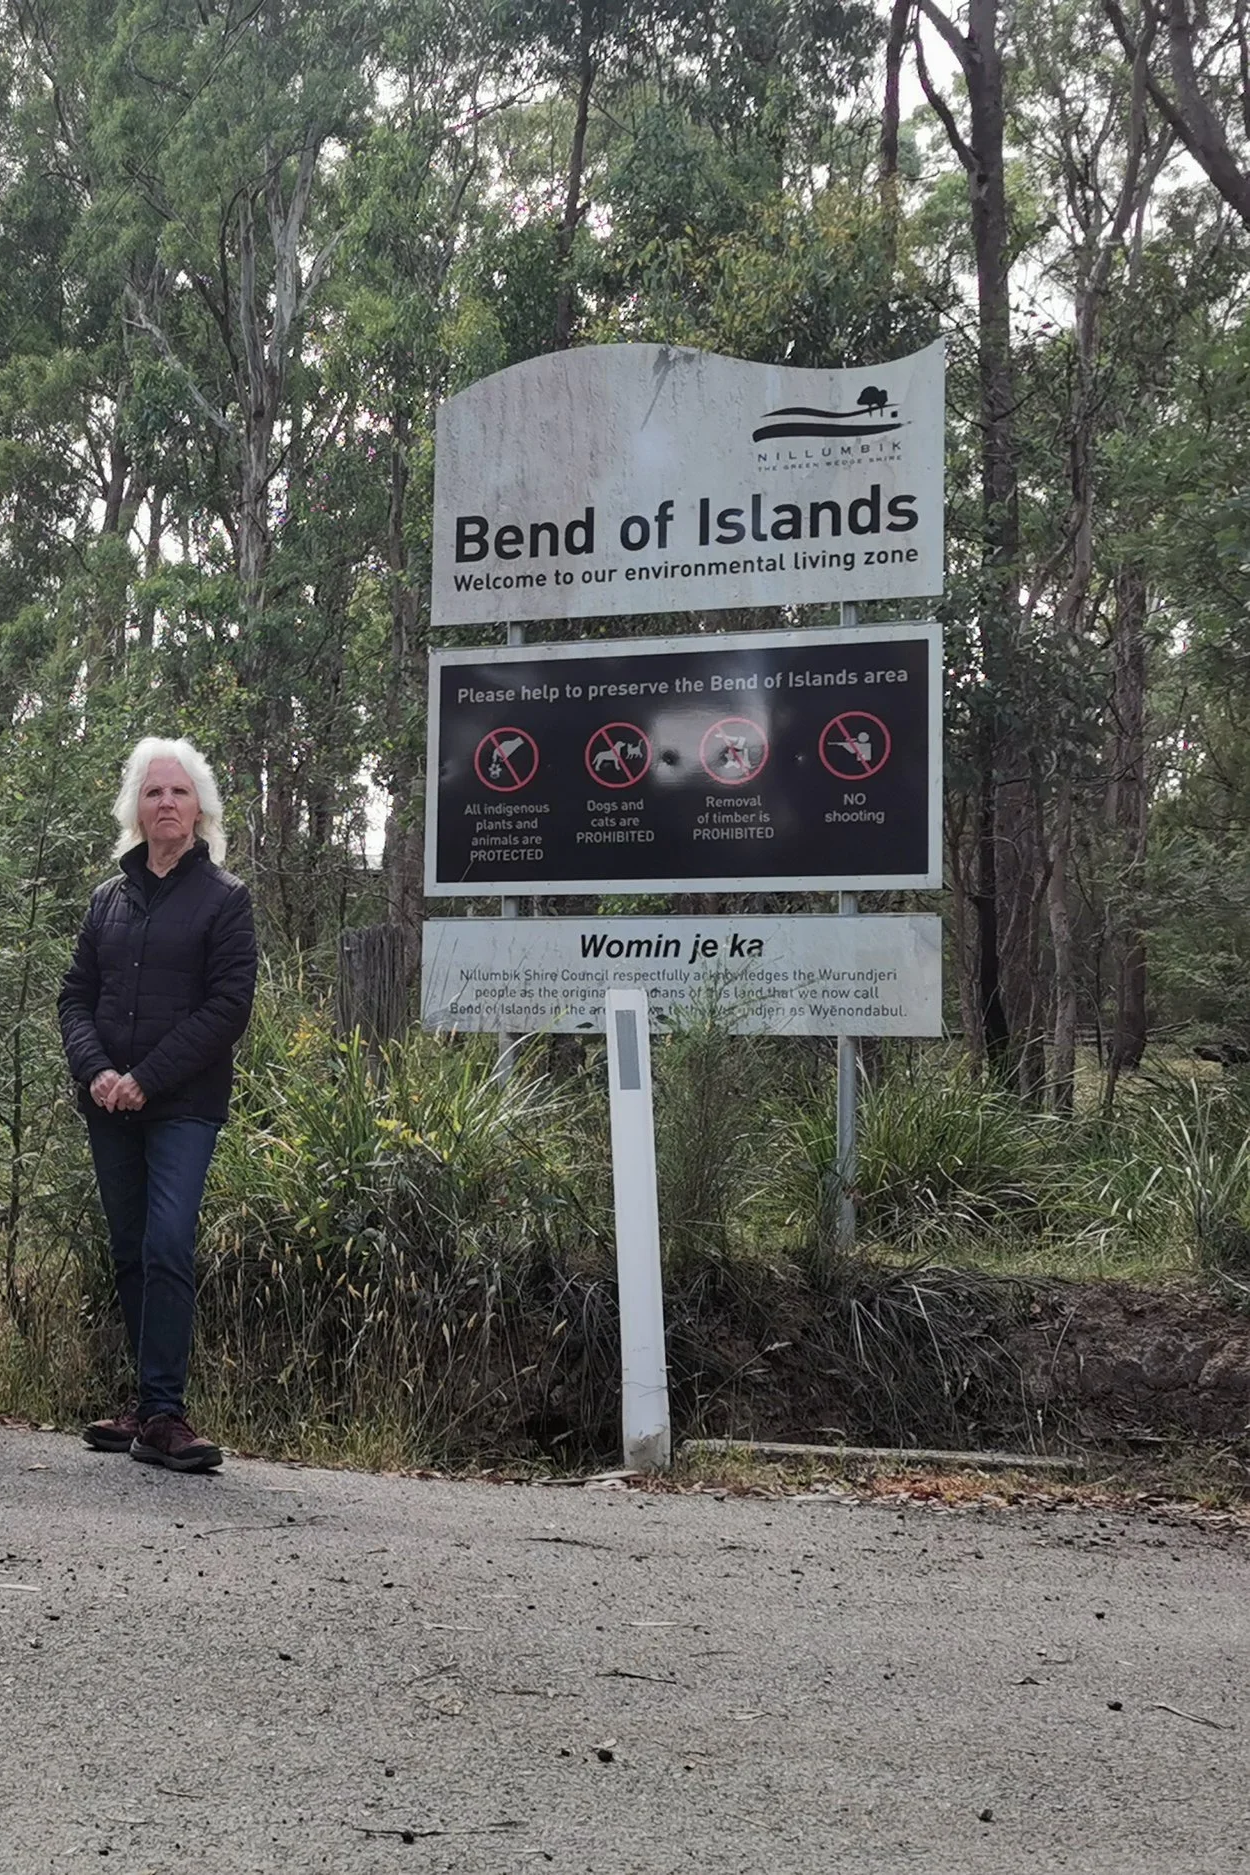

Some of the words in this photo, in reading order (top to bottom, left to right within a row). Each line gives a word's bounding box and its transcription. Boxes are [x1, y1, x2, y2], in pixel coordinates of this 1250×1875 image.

[758, 441, 902, 462] NILLUMBIK
[758, 465, 778, 473] THE
[783, 462, 820, 471] GREEN
[825, 458, 863, 467] WEDGE
[868, 454, 903, 462] SHIRE
[455, 506, 595, 563] Bend
[620, 500, 674, 551] of
[699, 484, 919, 546] Islands
[453, 572, 547, 592] Welcome
[554, 569, 574, 586] to
[581, 567, 618, 584] our
[625, 553, 786, 582] environmental
[794, 550, 855, 571] living
[863, 548, 919, 566] zone
[457, 688, 515, 704] Please
[521, 684, 559, 703] help
[565, 683, 583, 699] to
[588, 681, 670, 701] preserve
[674, 677, 704, 693] the
[710, 674, 758, 692] Bend
[764, 672, 783, 689] of
[788, 669, 858, 688] Islands
[864, 669, 908, 684] area
[586, 799, 619, 814] Dogs
[621, 798, 645, 811] and
[705, 795, 762, 808] Removal
[843, 793, 867, 806] NO
[464, 804, 481, 816] All
[484, 803, 550, 817] indigenous
[697, 812, 709, 824] of
[712, 811, 756, 824] timber
[759, 810, 771, 823] is
[824, 810, 886, 824] shooting
[476, 819, 513, 833] plants
[515, 818, 539, 830] and
[590, 816, 617, 828] cats
[619, 816, 640, 827] are
[576, 830, 655, 844] PROHIBITED
[693, 826, 775, 840] PROHIBITED
[471, 834, 520, 847] animals
[521, 835, 543, 845] are
[470, 848, 544, 862] PROTECTED
[580, 933, 681, 959] Womin
[688, 933, 719, 965] je
[729, 933, 764, 958] ka
[460, 969, 521, 982] Nillumbik
[524, 969, 558, 982] Shire
[561, 969, 609, 981] Council
[613, 969, 691, 984] respectfully
[793, 969, 815, 981] the
[818, 968, 897, 984] Wurundjeri
[475, 987, 517, 1000] people
[519, 989, 535, 999] as
[538, 987, 559, 999] the
[562, 986, 610, 1000] origina
[734, 988, 763, 999] land
[767, 987, 794, 999] that
[797, 989, 818, 999] we
[821, 989, 850, 999] now
[853, 986, 879, 999] call
[450, 1002, 482, 1015] Bend
[501, 1003, 546, 1015] Islands
[550, 1003, 562, 1015] in
[565, 1003, 585, 1015] the
[809, 1004, 908, 1019] Wyēnondabul.
